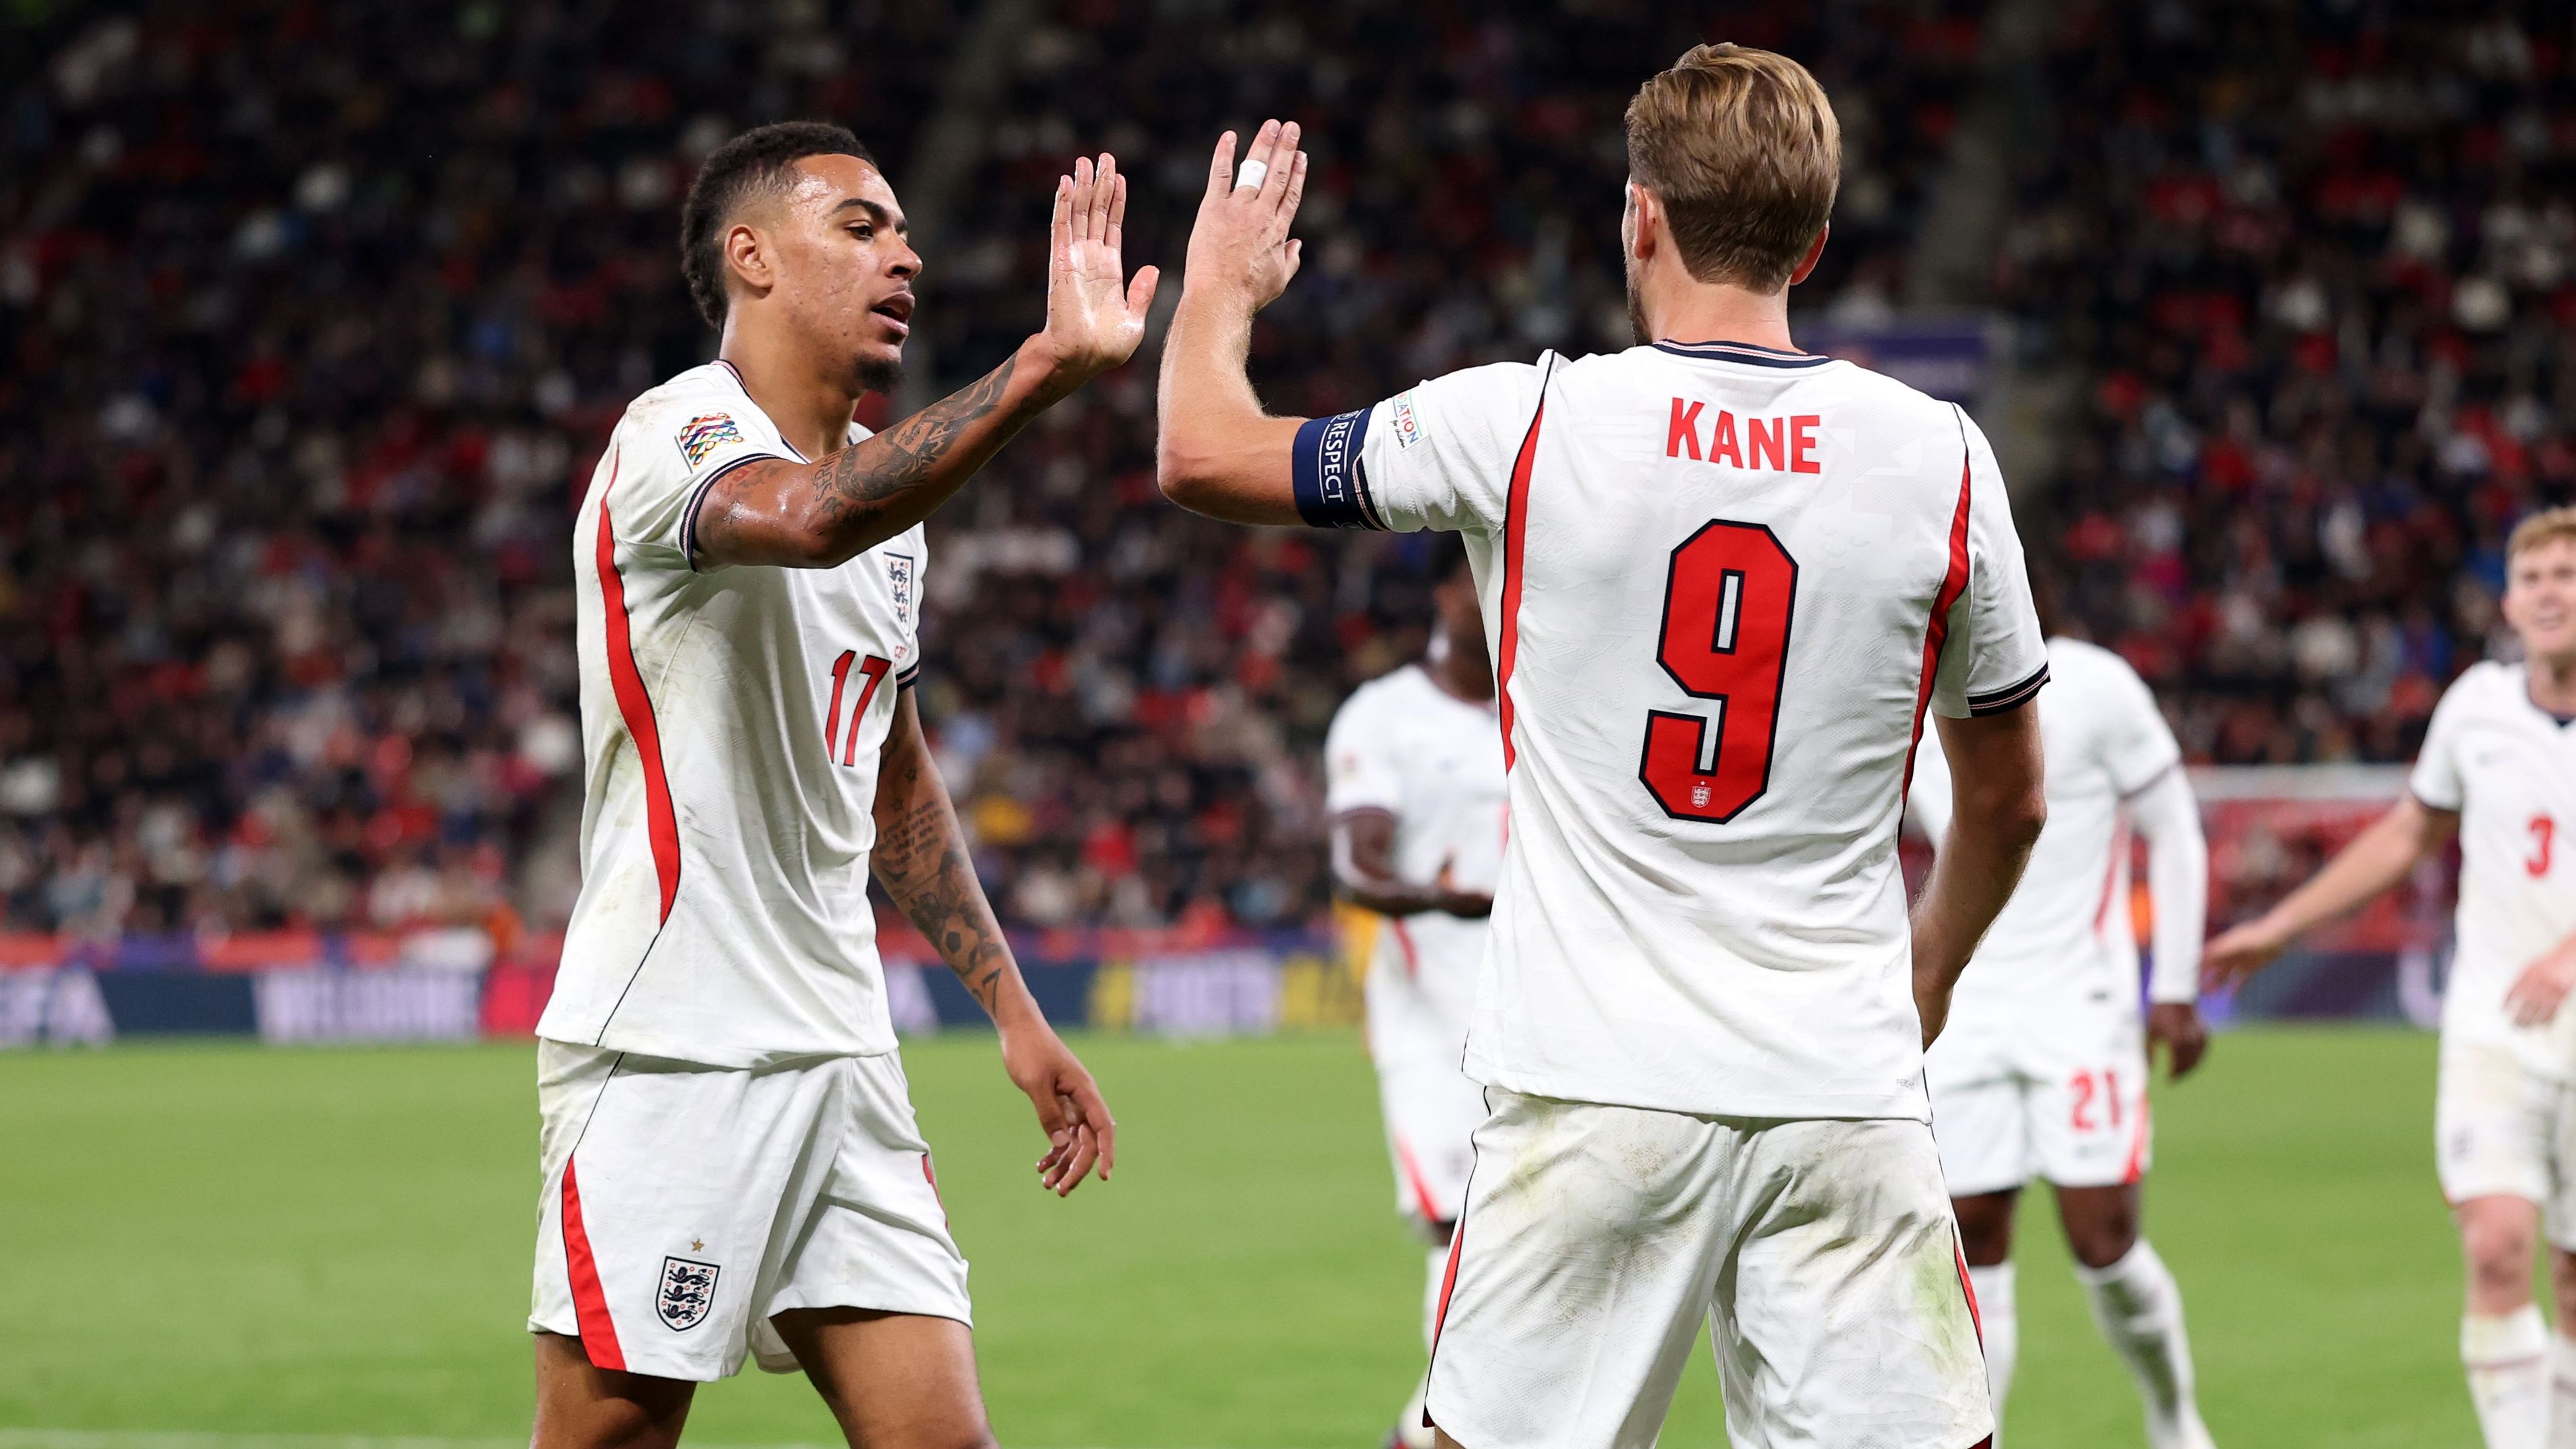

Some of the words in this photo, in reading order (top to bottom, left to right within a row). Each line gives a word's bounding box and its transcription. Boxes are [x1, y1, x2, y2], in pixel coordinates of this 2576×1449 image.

[1325, 421, 1349, 502] RESPECT
[1395, 428, 1405, 449] children
[1666, 397, 1820, 474] KANE
[825, 649, 892, 767] 17
[1638, 518, 1799, 825] 9
[2524, 812, 2555, 879] 3
[2071, 1067, 2121, 1132] 21
